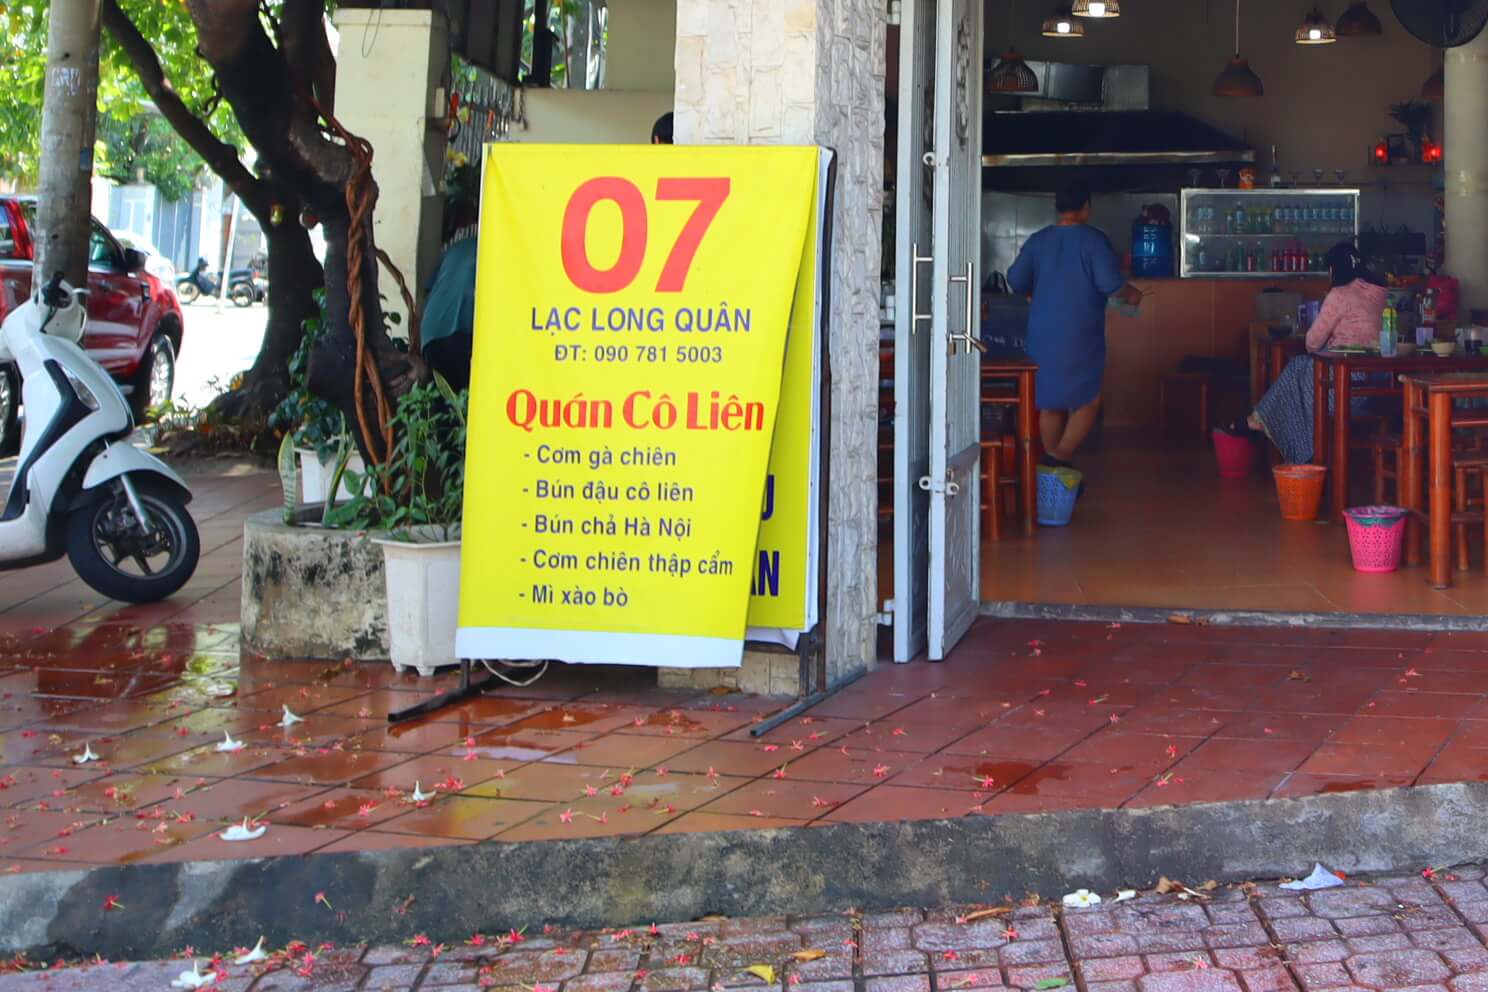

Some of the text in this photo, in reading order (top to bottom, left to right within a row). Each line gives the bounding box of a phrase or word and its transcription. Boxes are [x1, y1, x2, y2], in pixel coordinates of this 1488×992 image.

[561, 176, 731, 294] 07
[532, 301, 751, 336] LẠC LONG QUÂN
[555, 344, 723, 363] ĐT: 090 781 5003
[506, 389, 765, 432] Quán Cô Liên
[537, 444, 581, 464] Cơm
[588, 446, 613, 470] gà
[620, 447, 676, 466] chiên
[536, 479, 574, 499] Bún
[582, 480, 619, 504] đậu
[626, 482, 650, 501] cô
[658, 482, 693, 502] liên
[535, 514, 573, 534] Bún
[581, 514, 617, 536] chả
[624, 516, 651, 537] Hà
[658, 517, 691, 541] Nội
[533, 549, 578, 569] Cơm
[585, 551, 640, 571] chiên
[648, 553, 691, 578] thập
[698, 550, 733, 575] cẩm
[532, 584, 553, 604] Mì
[561, 585, 596, 606] xào
[603, 587, 628, 607] bò
